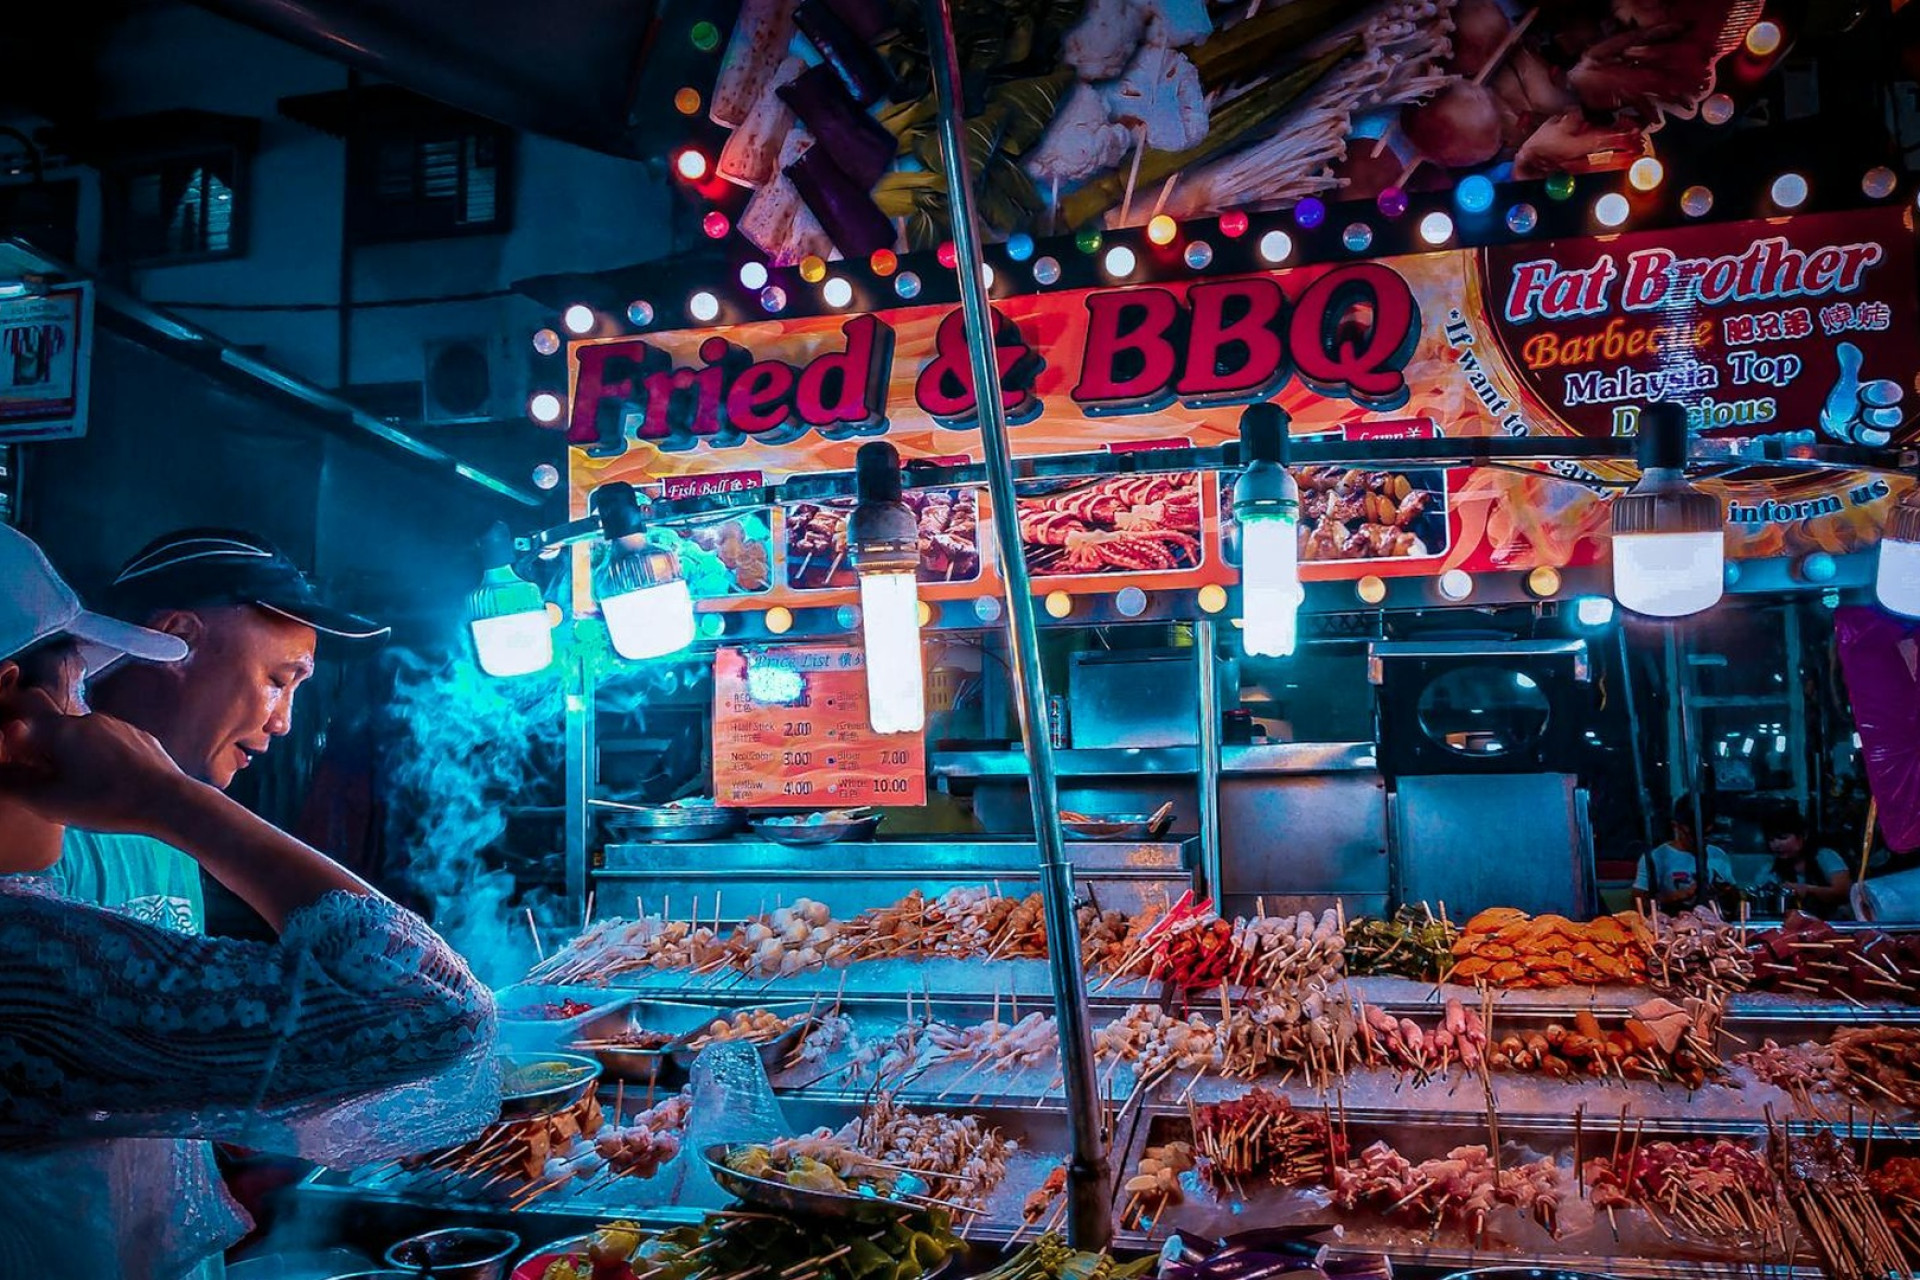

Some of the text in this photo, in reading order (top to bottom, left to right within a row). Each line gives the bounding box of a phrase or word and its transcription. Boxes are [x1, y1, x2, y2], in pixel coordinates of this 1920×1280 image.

[1505, 236, 1882, 321] Fat Brother
[567, 262, 1420, 450] Fried & BBQ
[1564, 350, 1801, 406] Malaysia Top
[1611, 397, 1776, 437] Dcious
[1459, 350, 1510, 415] want
[1502, 412, 1529, 438] to
[1727, 495, 1845, 525] inform
[1850, 478, 1890, 507] us
[668, 479, 729, 499] Fish Ball
[754, 653, 831, 670] Price List
[783, 722, 812, 736] 2.00
[783, 751, 812, 765] 3.00
[881, 750, 909, 765] 7.00
[783, 780, 813, 795] 4.00
[873, 779, 907, 793] 10.00
